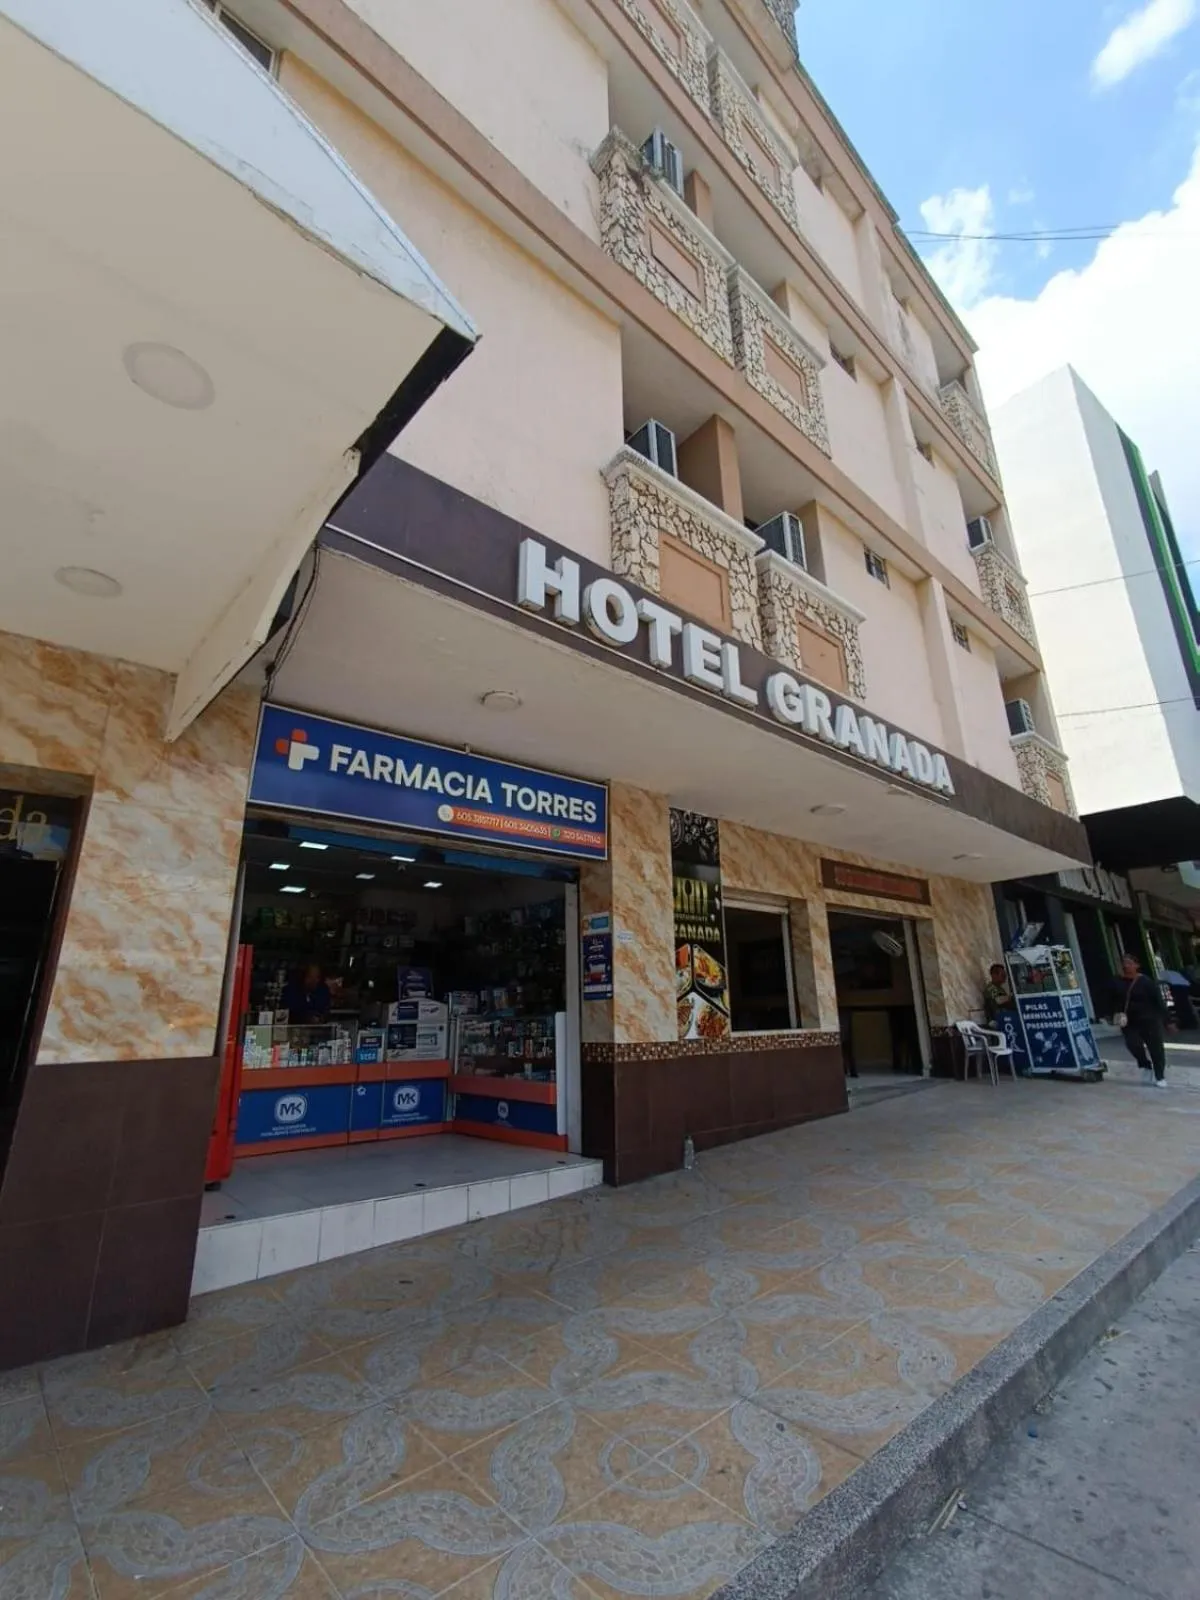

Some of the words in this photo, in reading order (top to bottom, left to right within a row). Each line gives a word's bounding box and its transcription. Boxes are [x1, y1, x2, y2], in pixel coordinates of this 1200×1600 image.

[518, 537, 759, 708] HOTEL
[766, 671, 956, 796] GRANADA
[329, 743, 493, 804] FARMACIA
[501, 781, 598, 824] TORRES
[1025, 1002, 1049, 1012] PILAS
[397, 1091, 417, 1106] MK
[279, 1101, 303, 1117] MK
